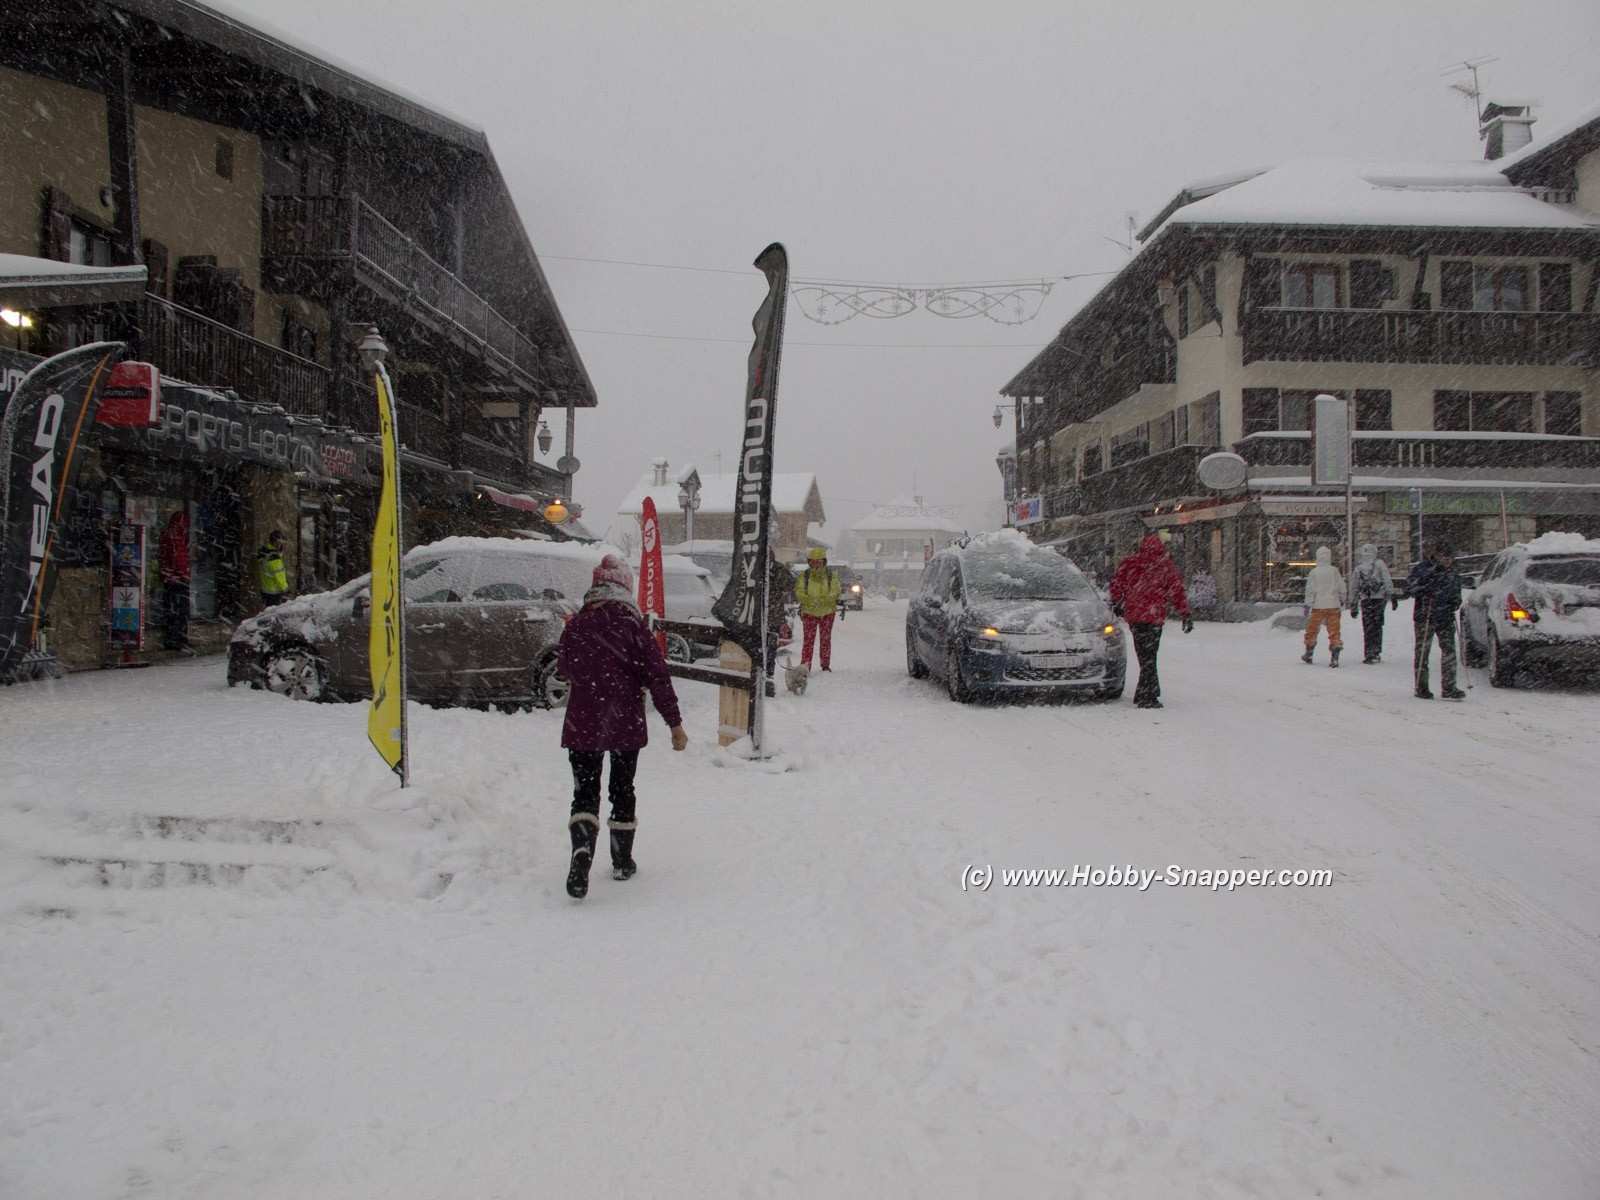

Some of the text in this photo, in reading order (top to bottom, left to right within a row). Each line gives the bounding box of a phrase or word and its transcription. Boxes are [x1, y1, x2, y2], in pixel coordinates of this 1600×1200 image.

[148, 402, 243, 451] SPORTS
[320, 443, 357, 465] LOCATION
[322, 458, 353, 478] RENTAL
[1285, 506, 1304, 514] VINS
[1314, 506, 1354, 515] LIQUEU
